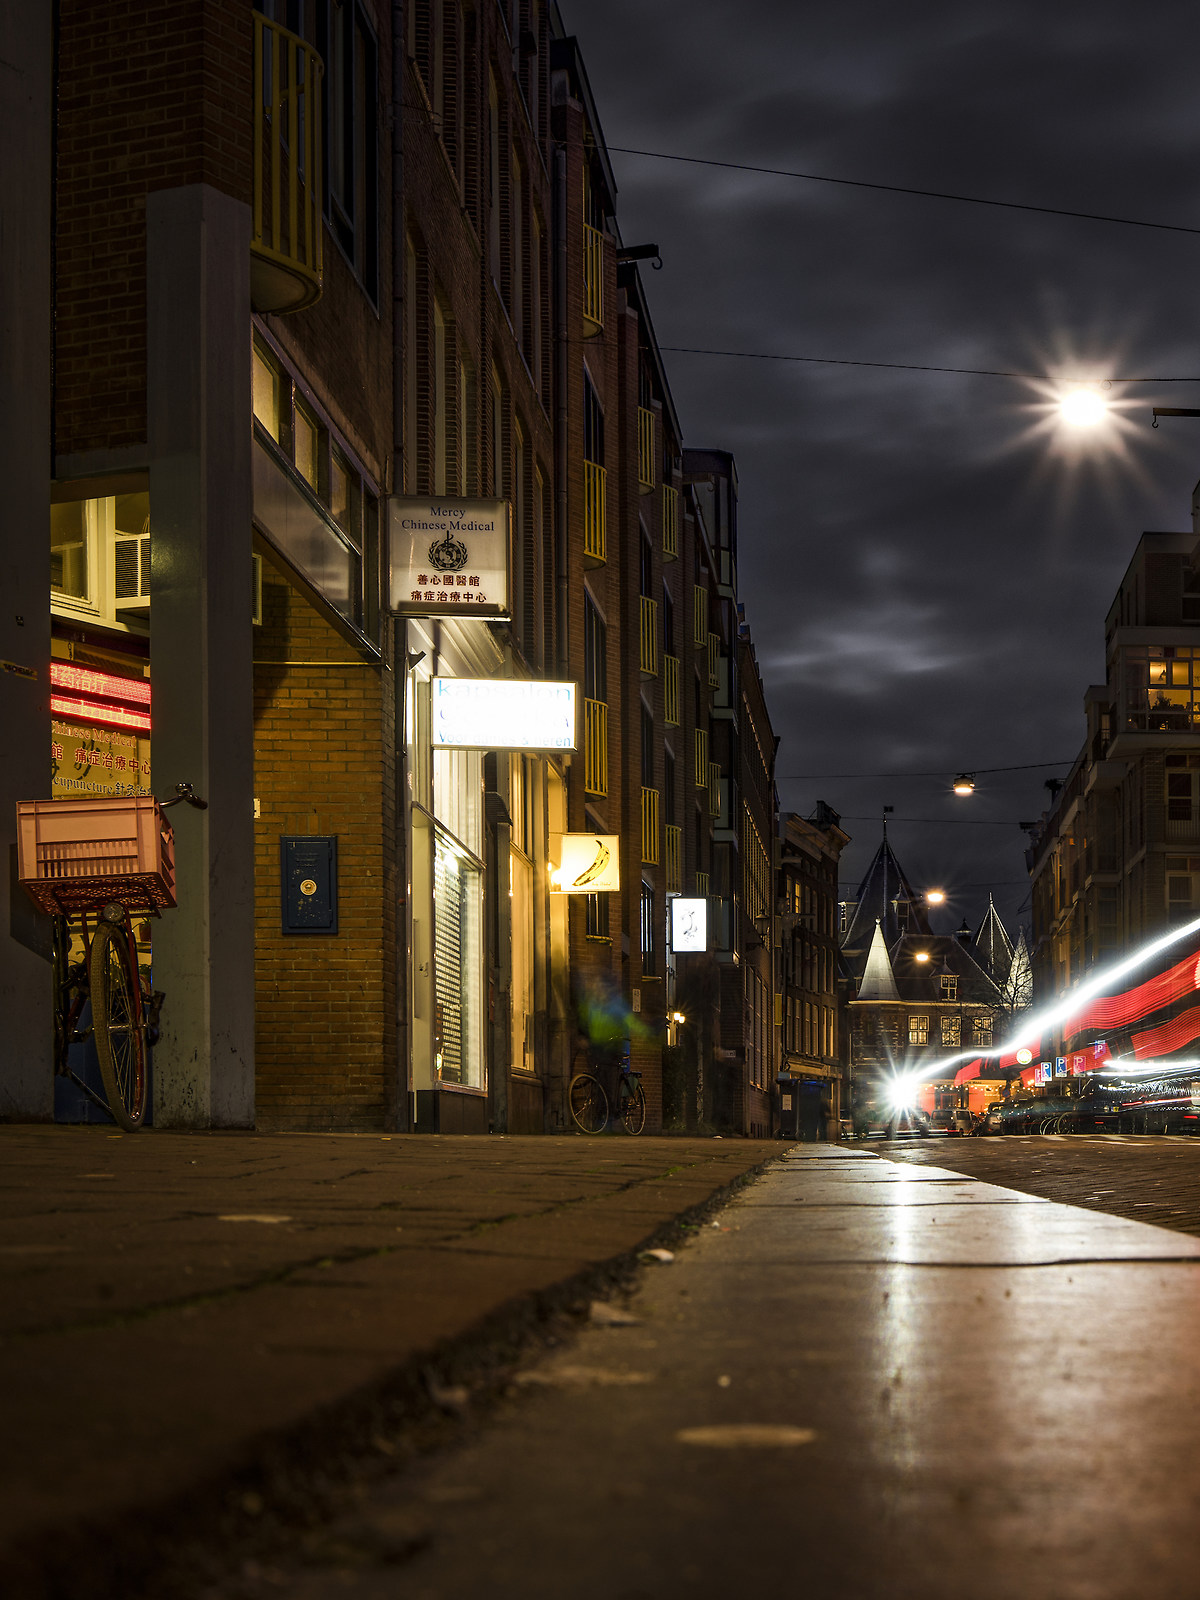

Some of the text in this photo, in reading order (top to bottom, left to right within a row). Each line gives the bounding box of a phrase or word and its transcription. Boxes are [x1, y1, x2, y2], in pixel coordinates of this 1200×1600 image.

[430, 506, 466, 519] Mercy
[401, 519, 495, 531] Chinese Medical
[417, 574, 481, 587] 善心國醫館
[410, 590, 487, 603] 痛症治療中心
[92, 728, 137, 748] Medical
[438, 729, 468, 744] Voor
[53, 777, 113, 795] cupuncture
